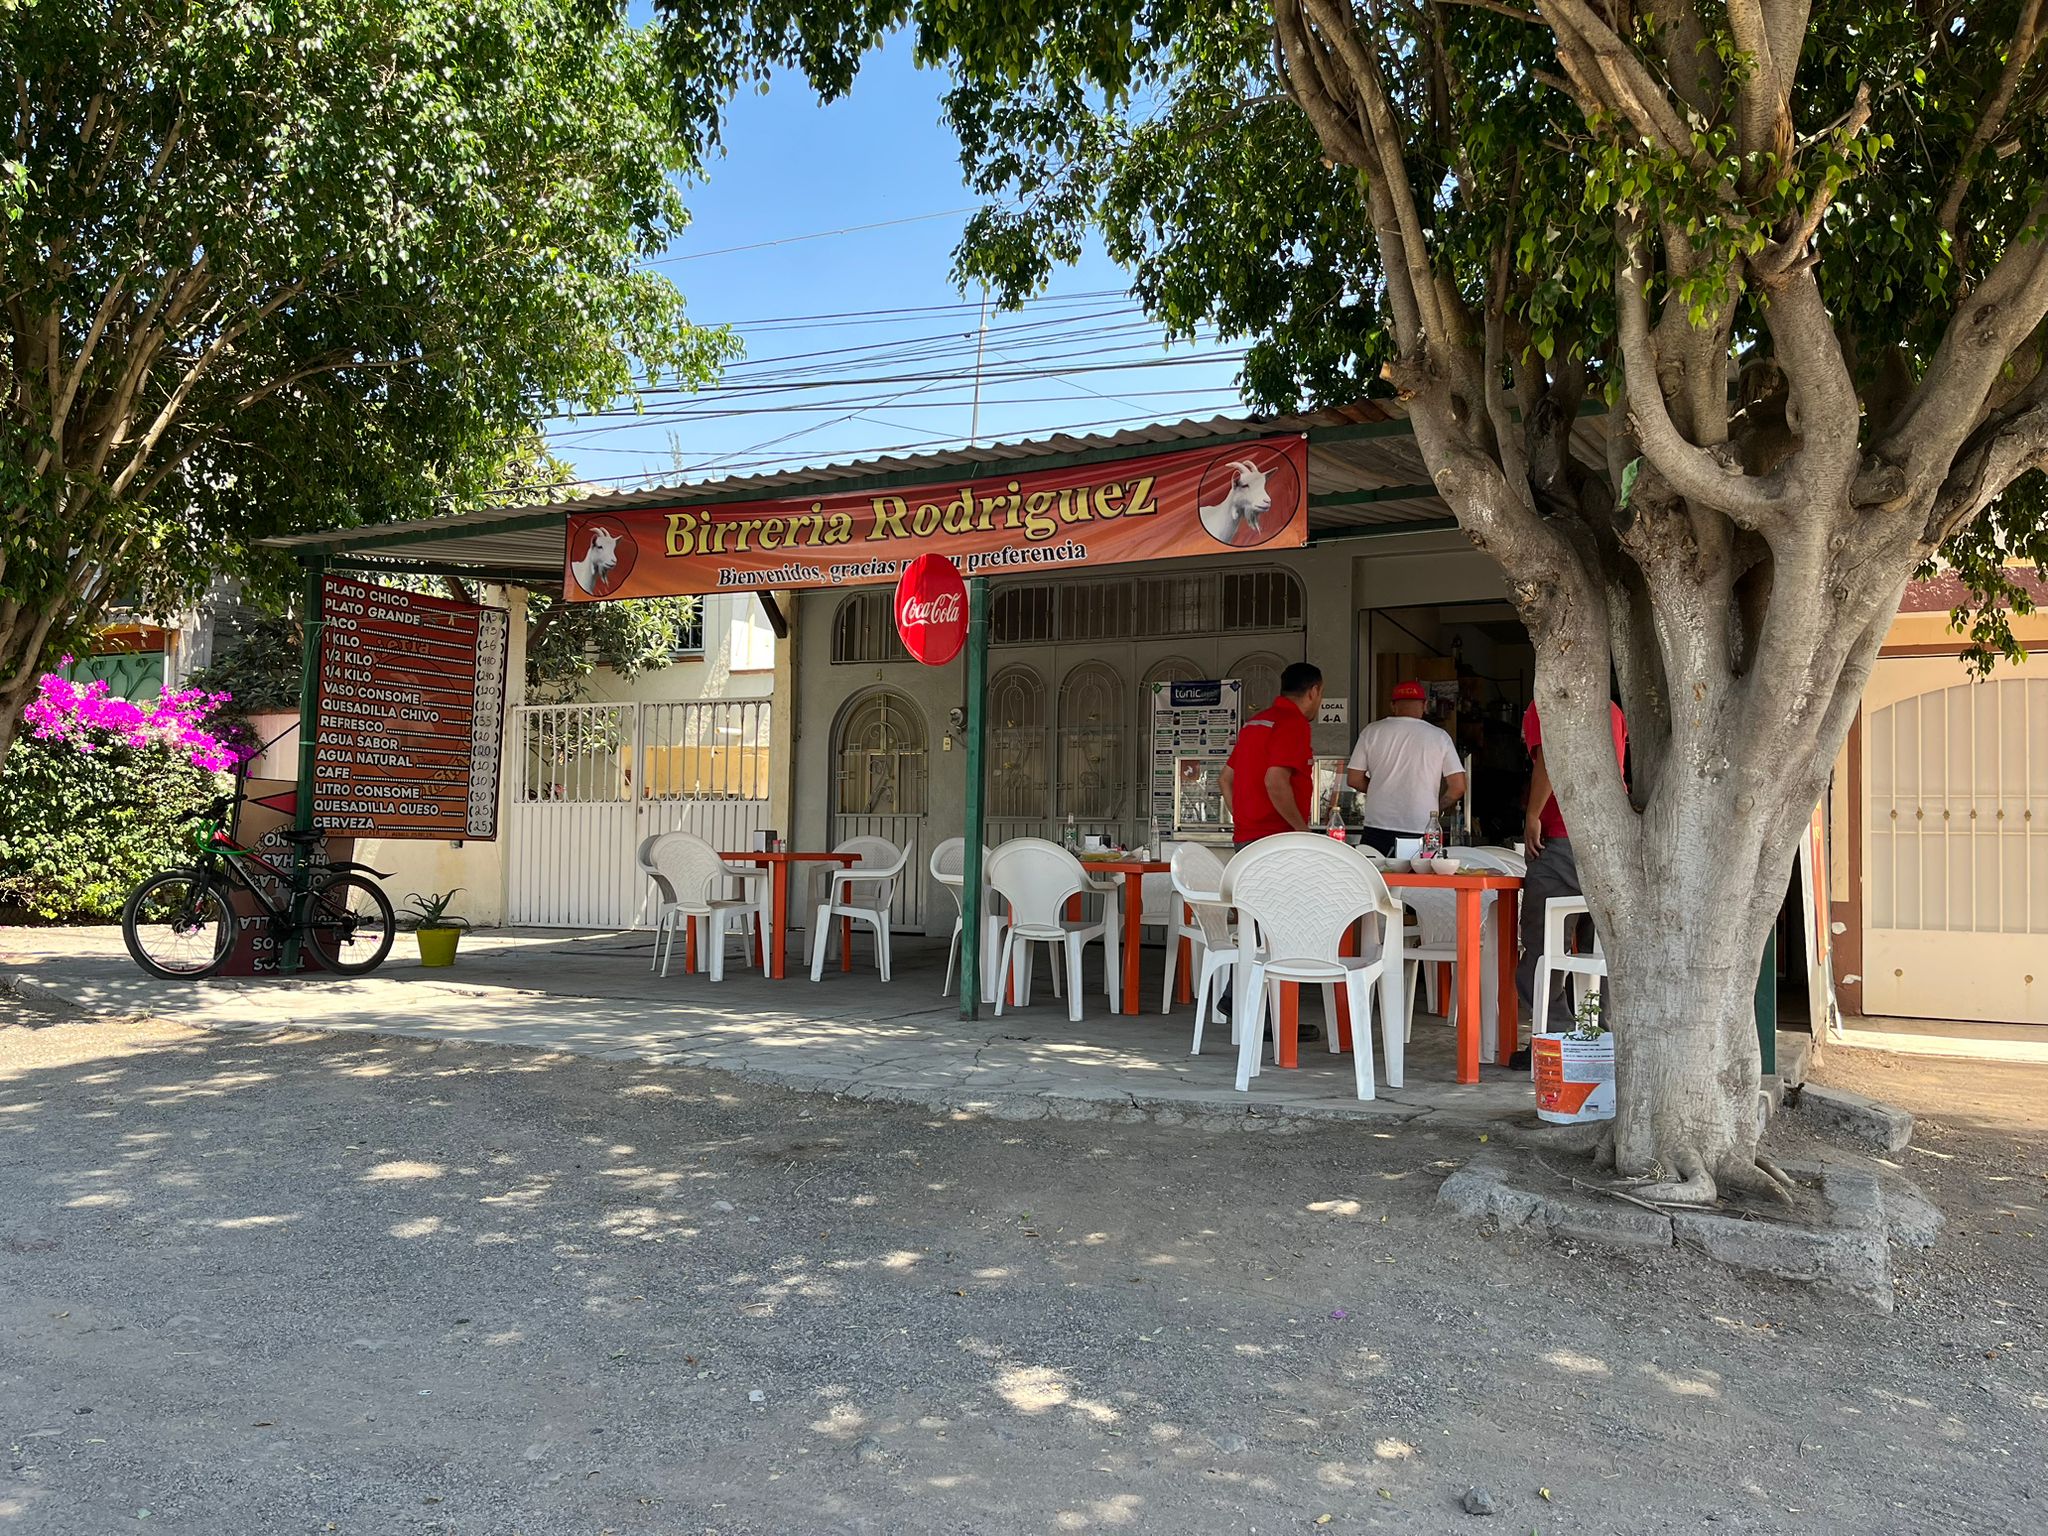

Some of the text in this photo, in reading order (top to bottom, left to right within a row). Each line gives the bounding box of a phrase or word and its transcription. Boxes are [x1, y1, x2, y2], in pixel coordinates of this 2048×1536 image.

[665, 476, 1157, 557] Birreria Rodriguez
[967, 539, 1088, 573] preferencia
[717, 562, 826, 586] Bienvenidos,
[830, 558, 896, 582] gracias
[325, 581, 366, 600] PLATO
[369, 590, 409, 608] CHICO
[325, 598, 364, 615] PLATO
[367, 606, 421, 626] GRANDE
[902, 593, 962, 627] Coca-Cola
[324, 614, 358, 631] TACO
[325, 631, 331, 643] 1
[333, 633, 360, 648] KILO
[325, 648, 342, 662] 1/2
[344, 650, 373, 667] KILO
[324, 665, 342, 678] 1/4
[344, 666, 372, 682] KILO
[323, 681, 356, 697] VASO
[357, 686, 420, 705] CONSOME
[322, 699, 397, 718] QUESADILLA
[400, 708, 439, 722] CHIVO
[1322, 714, 1342, 723] 4-A
[320, 715, 384, 733] REFRESCO
[318, 732, 354, 746] AGUA
[356, 735, 399, 750] SABOR
[317, 749, 353, 763] AGUA
[356, 753, 413, 768] NATURAL
[316, 766, 350, 779] CAFE
[315, 782, 351, 796] LITRO
[354, 785, 420, 799] CONSOME
[313, 799, 395, 814] QUESADILLA
[399, 803, 439, 816] QUESO
[312, 816, 375, 829] CERVEZA
